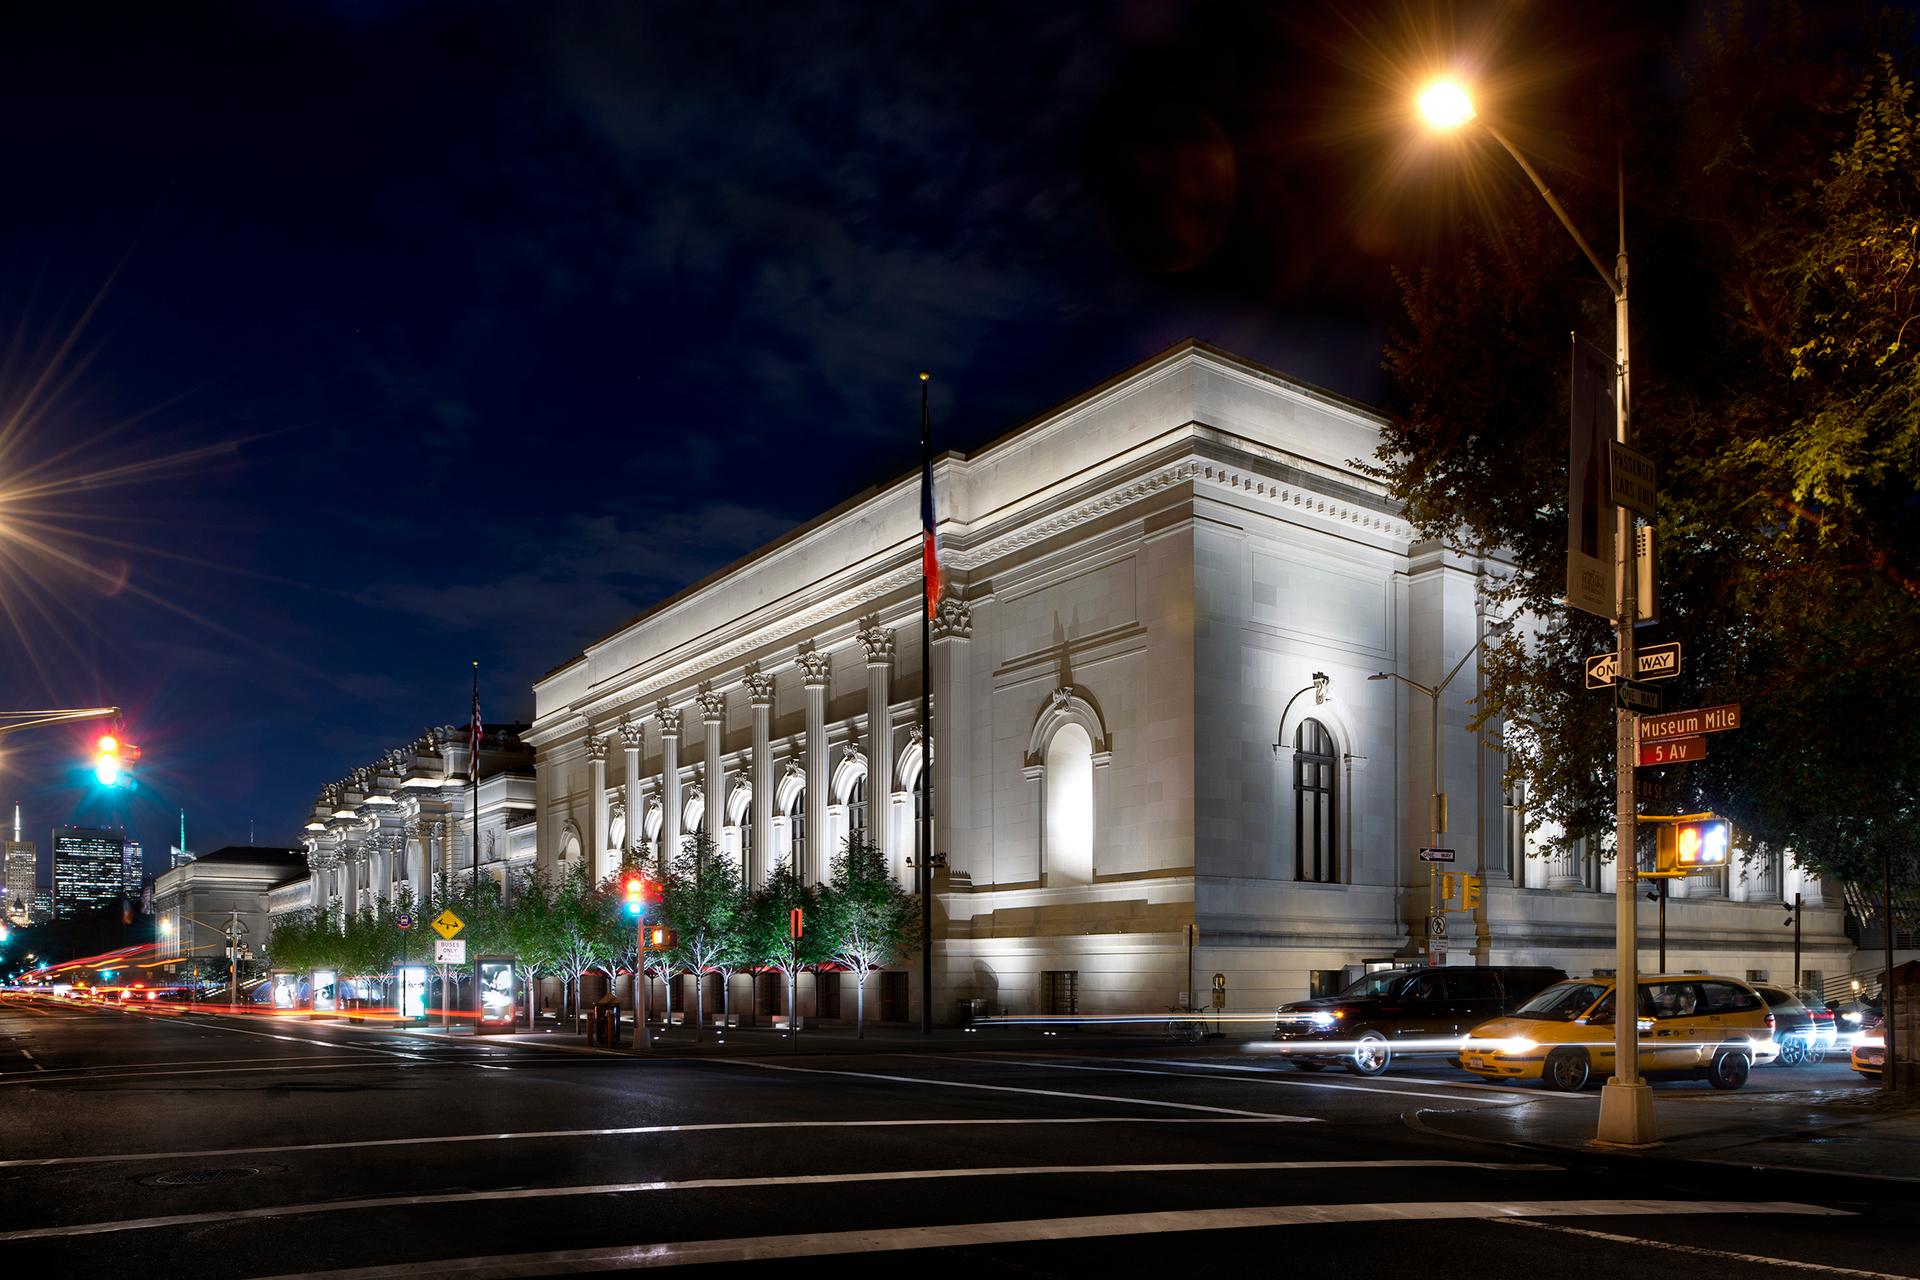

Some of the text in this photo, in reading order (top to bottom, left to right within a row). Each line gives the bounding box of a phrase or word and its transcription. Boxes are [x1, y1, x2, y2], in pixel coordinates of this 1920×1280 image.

[1615, 449, 1655, 481] PASSENGER
[1615, 475, 1655, 507] CARS ONLY
[1597, 654, 1671, 677] ON WAY
[1622, 687, 1656, 706] ONE WAY
[1641, 717, 1698, 738] Museum
[1705, 710, 1736, 729] Mile
[1655, 743, 1687, 762] 5 Av
[1642, 780, 1652, 797] 84
